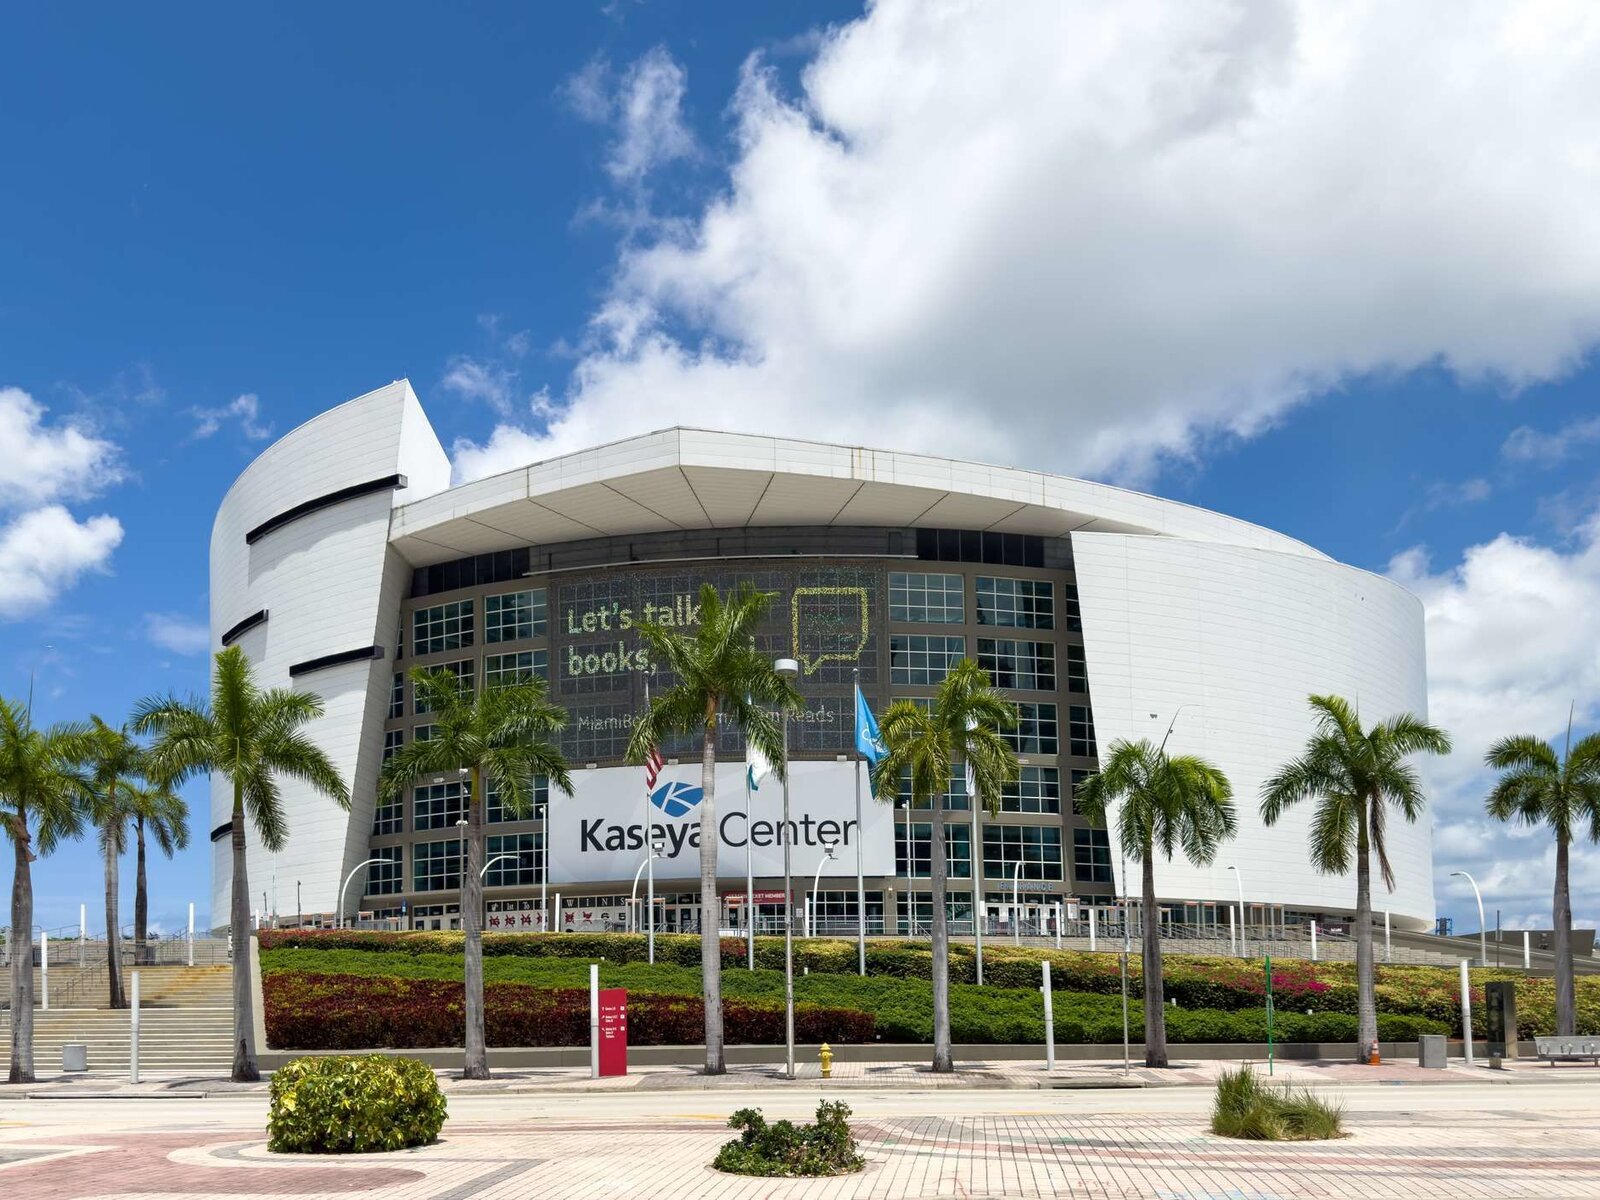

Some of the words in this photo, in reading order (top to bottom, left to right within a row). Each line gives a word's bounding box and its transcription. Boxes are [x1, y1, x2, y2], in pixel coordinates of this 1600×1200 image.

[567, 602, 633, 634] Let's
[643, 594, 702, 626] talk
[581, 818, 702, 859] Kaseya
[719, 811, 858, 848] Center
